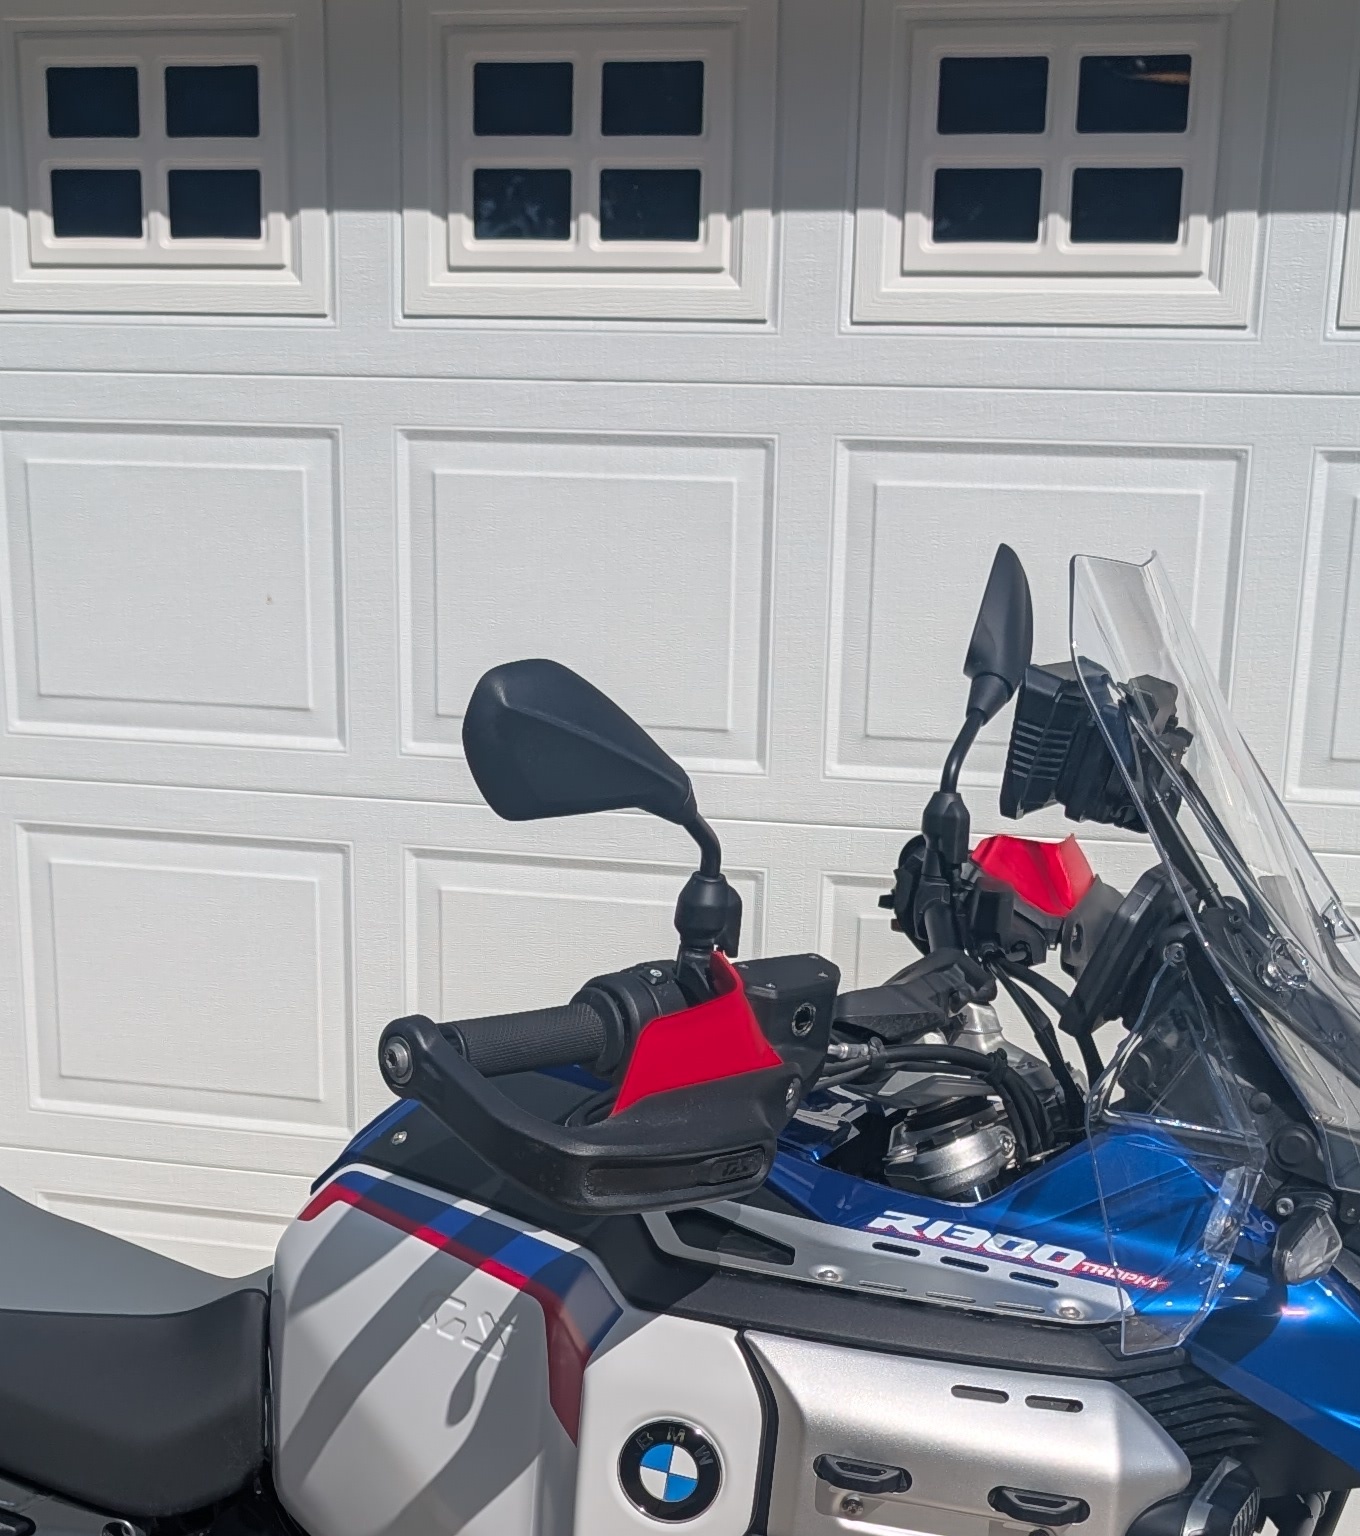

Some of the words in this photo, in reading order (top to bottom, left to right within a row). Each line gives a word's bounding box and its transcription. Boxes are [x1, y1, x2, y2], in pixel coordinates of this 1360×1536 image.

[867, 1210, 1088, 1271] R1300
[1082, 1261, 1166, 1289] TROPHY
[634, 1425, 714, 1466] BMW
